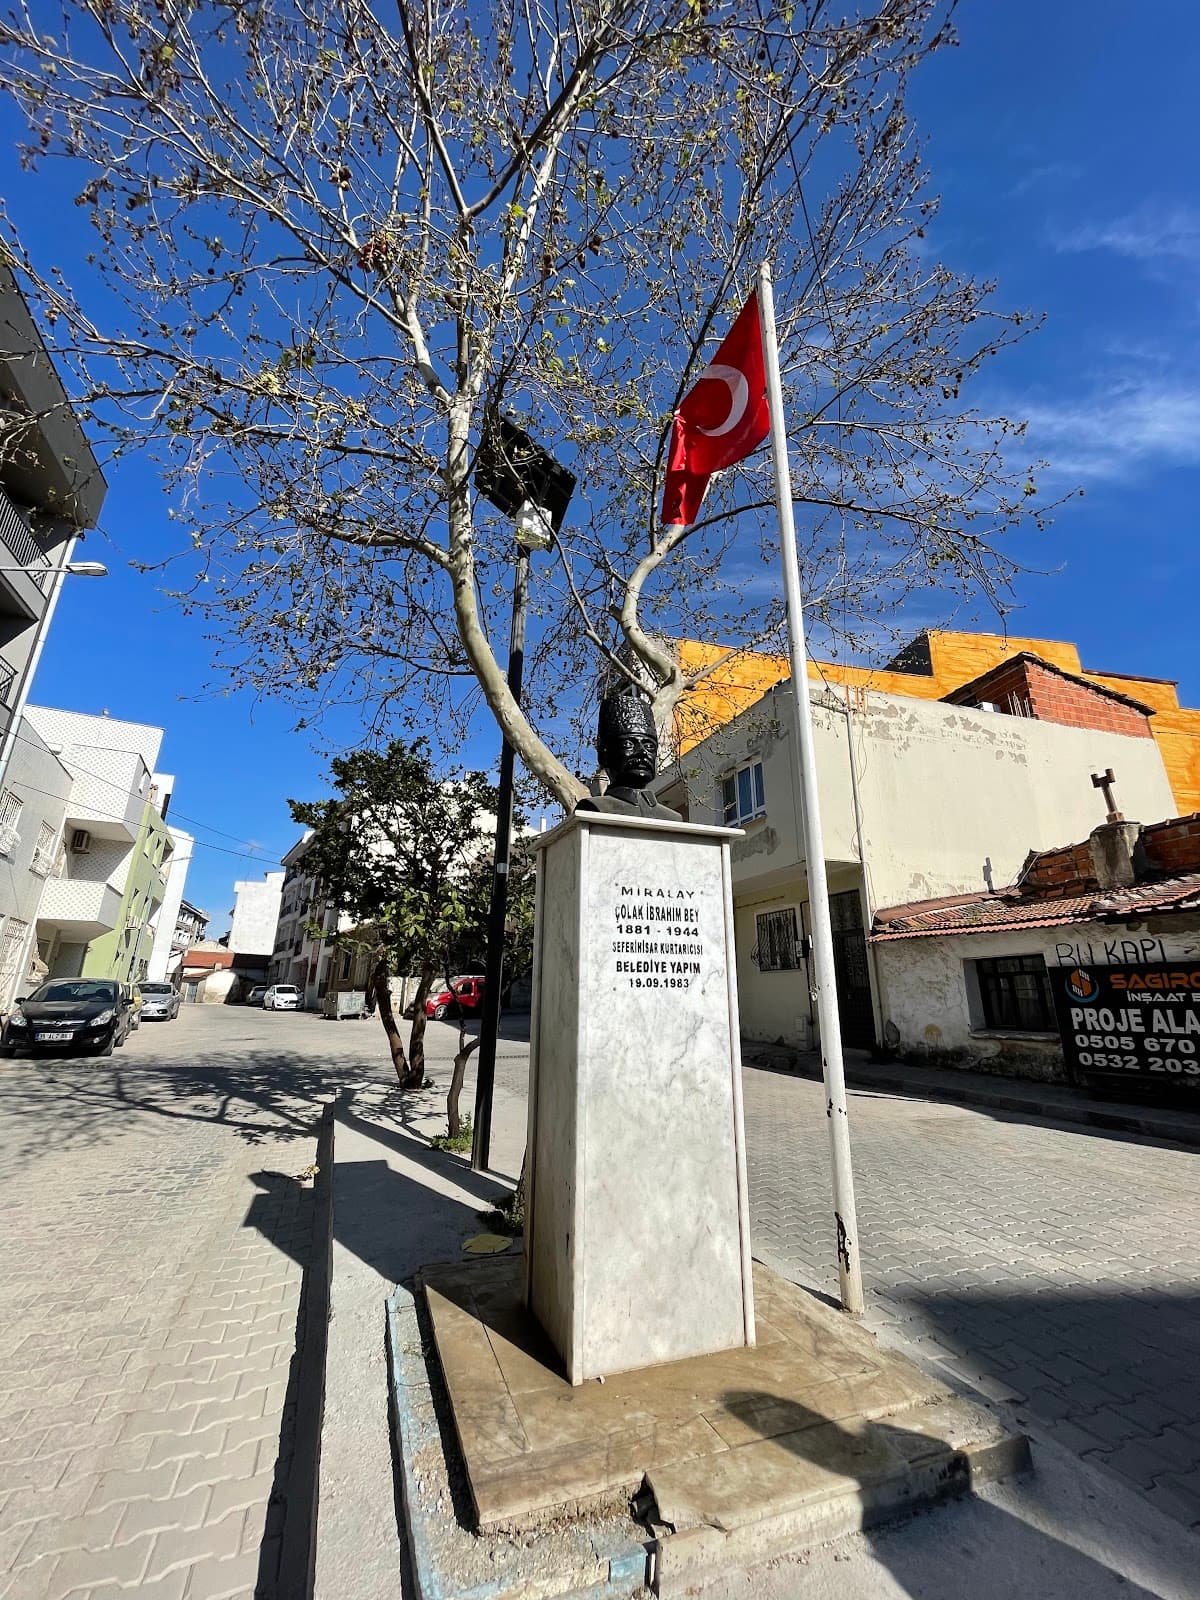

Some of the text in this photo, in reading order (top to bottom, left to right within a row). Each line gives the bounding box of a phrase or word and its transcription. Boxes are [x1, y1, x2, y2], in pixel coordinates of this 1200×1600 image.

[621, 886, 695, 899] MIRALAY
[615, 904, 644, 923] ÇOLAK
[684, 908, 699, 922] BEY
[617, 924, 651, 935] 1881
[666, 926, 699, 936] 1944
[612, 939, 703, 955] SEFERİHİSAR KURTARICISI
[1104, 939, 1167, 964] KAPI
[616, 959, 701, 974] BELEDİYE YAPIM
[630, 977, 689, 988] 19.09.1983
[1127, 991, 1186, 1004] İNŞAAT
[1070, 1007, 1200, 1035] PROJE ALA
[1075, 1034, 1196, 1054] 0505 670
[1078, 1052, 1200, 1075] 0532 203
